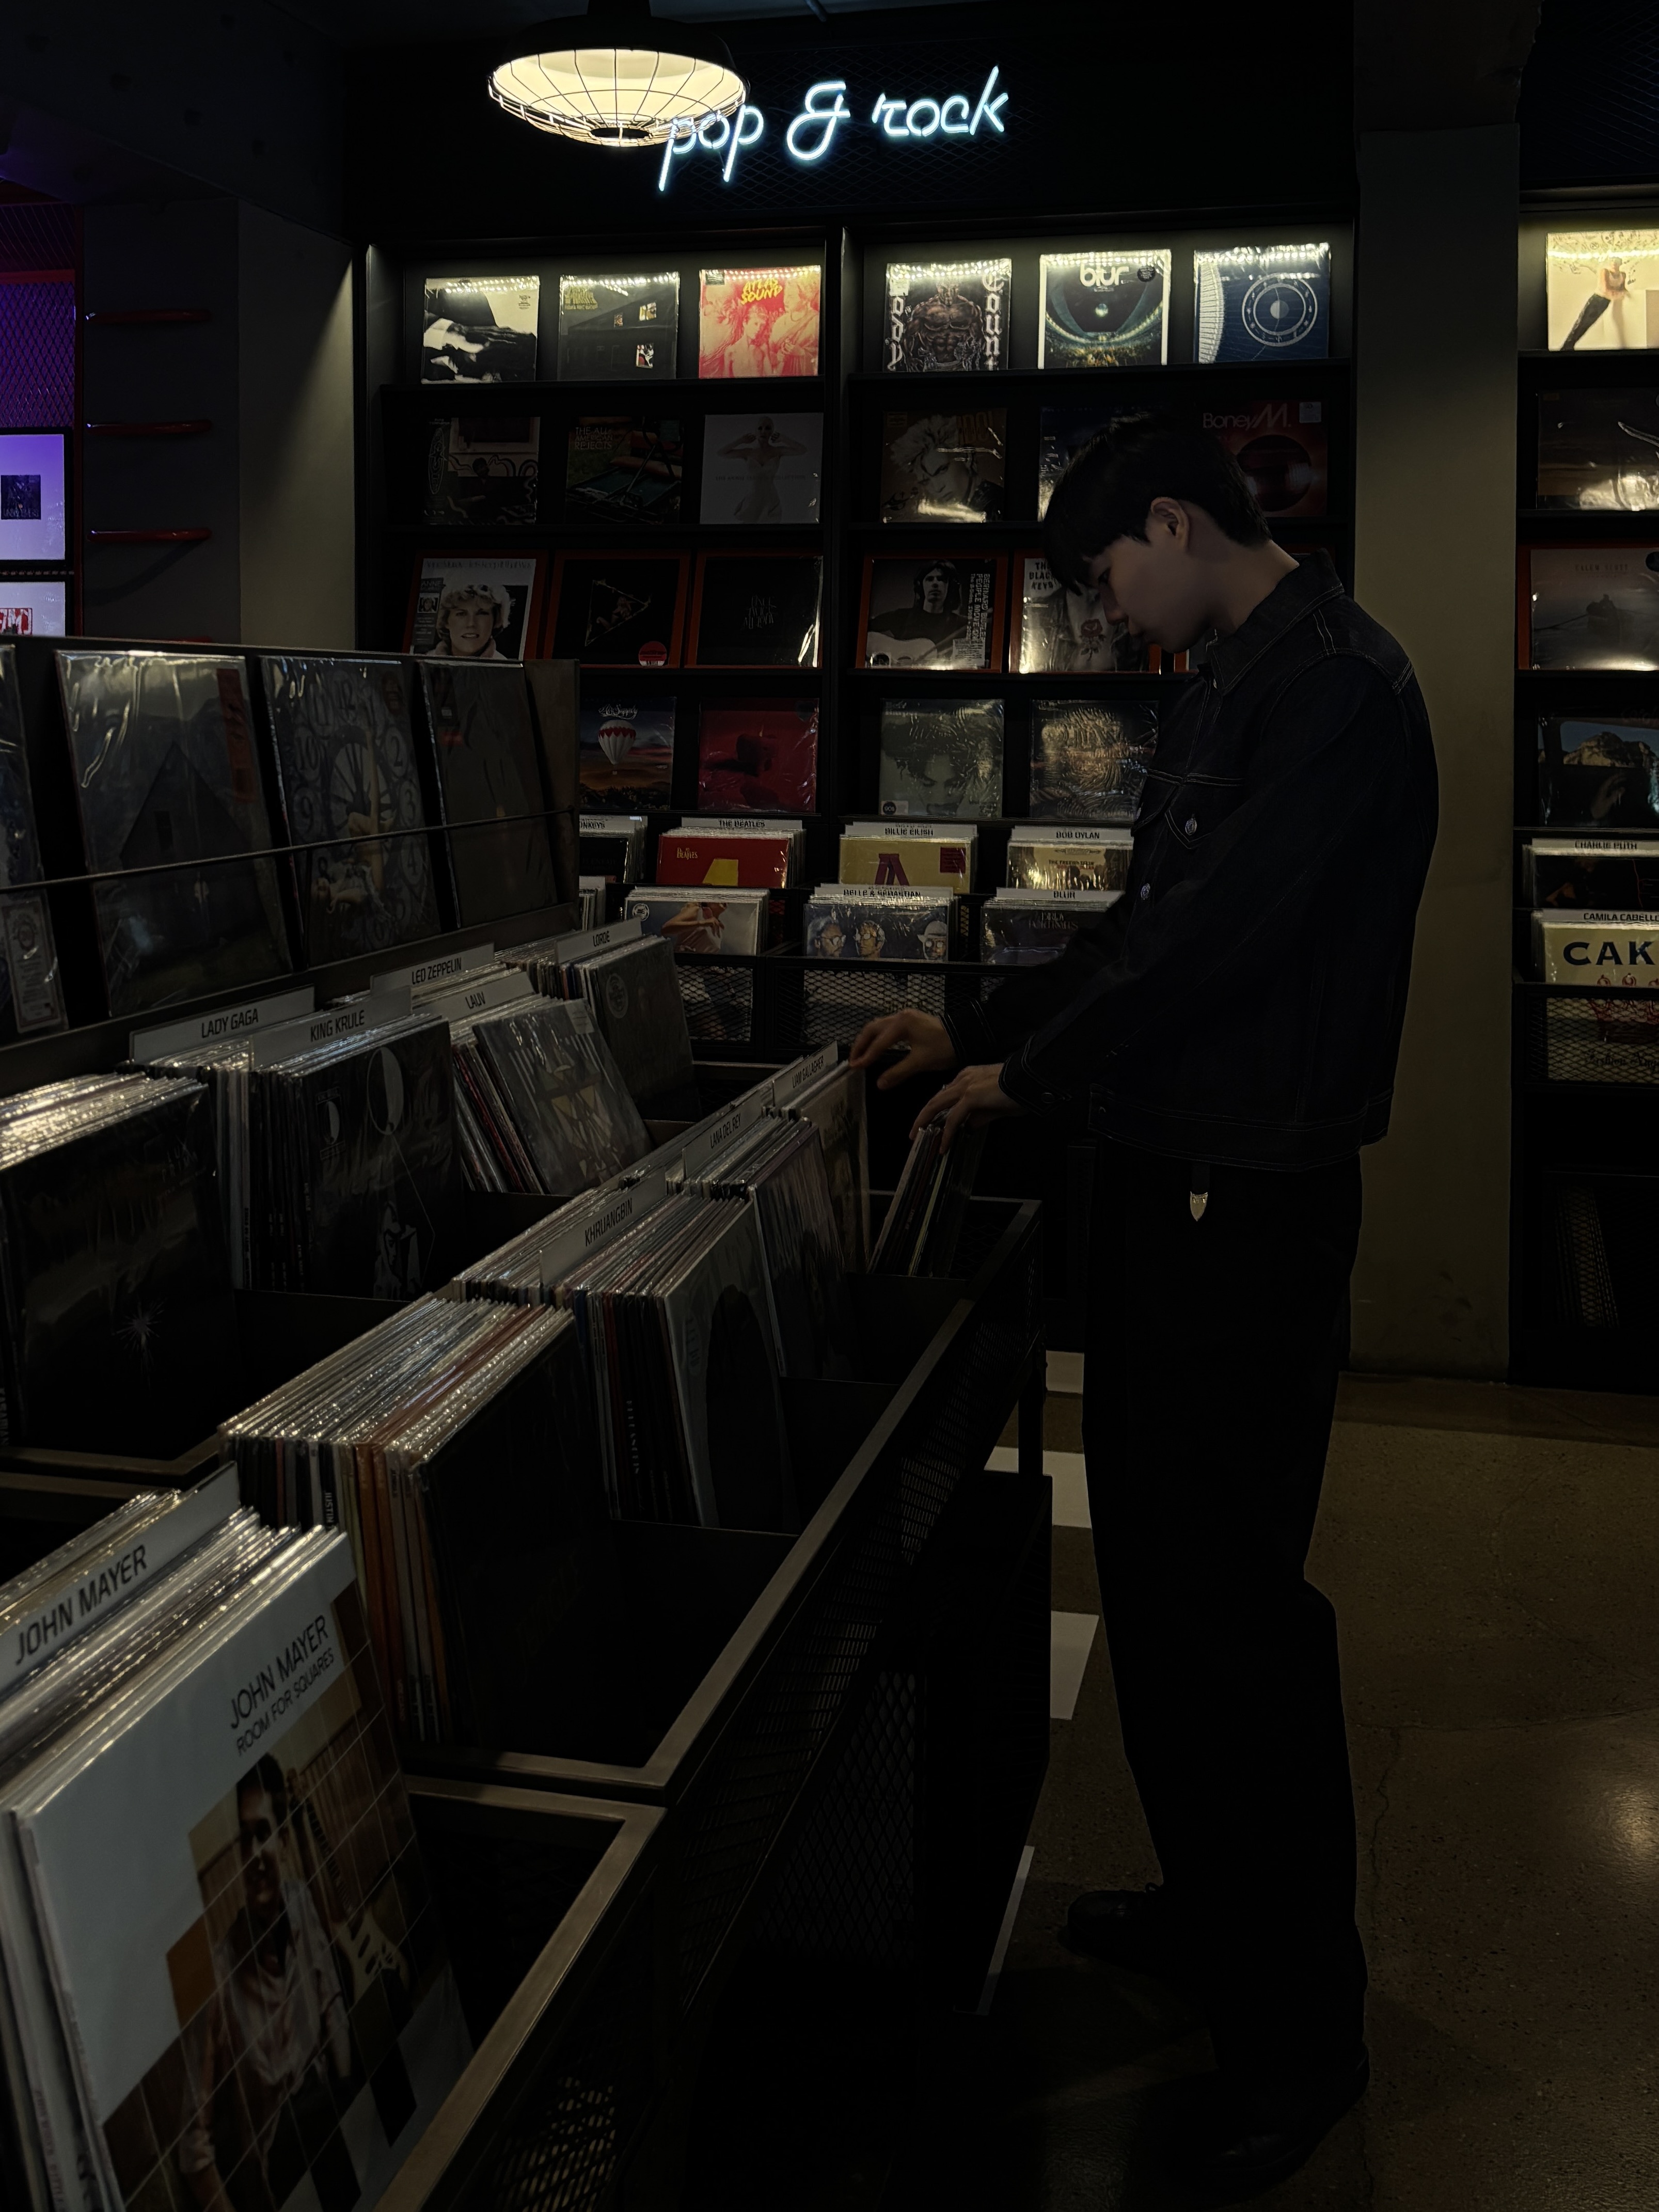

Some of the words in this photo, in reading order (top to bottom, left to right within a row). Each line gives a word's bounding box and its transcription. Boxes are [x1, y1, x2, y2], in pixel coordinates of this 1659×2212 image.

[658, 103, 764, 192] pop
[872, 64, 1010, 137] rock
[744, 278, 779, 290] ATLAS
[1080, 260, 1129, 287] blur
[741, 286, 783, 305] SOUND
[1203, 413, 1258, 426] Boney
[1252, 403, 1291, 423] M.
[575, 426, 591, 435] THE
[574, 441, 612, 450] REJECTS
[974, 573, 983, 603] PEOPLE
[1614, 841, 1637, 849] PUTH
[1584, 913, 1618, 921] CAMILA
[593, 930, 610, 947] LORDE
[412, 968, 426, 985] LED
[428, 957, 461, 980] ZEPPELIN
[465, 991, 485, 1009] LAUV
[201, 1016, 229, 1038] LADY
[231, 1008, 259, 1030] GAGA
[311, 1020, 333, 1042] KING
[336, 1009, 365, 1034] KRULE
[710, 1127, 722, 1149] LANA
[723, 1121, 732, 1139] DEL
[732, 1113, 741, 1131] REY
[584, 1197, 633, 1247] KHRUANGBIN
[324, 1492, 335, 1523] JUSTIN
[15, 1596, 73, 1666] JOHN
[78, 1544, 147, 1617] MAYER
[231, 1663, 276, 1730] JOHN
[276, 1614, 329, 1682] MAYER
[236, 1711, 271, 1757] ROOM
[271, 1689, 293, 1723] FOR
[293, 1647, 334, 1699] SQUARES
